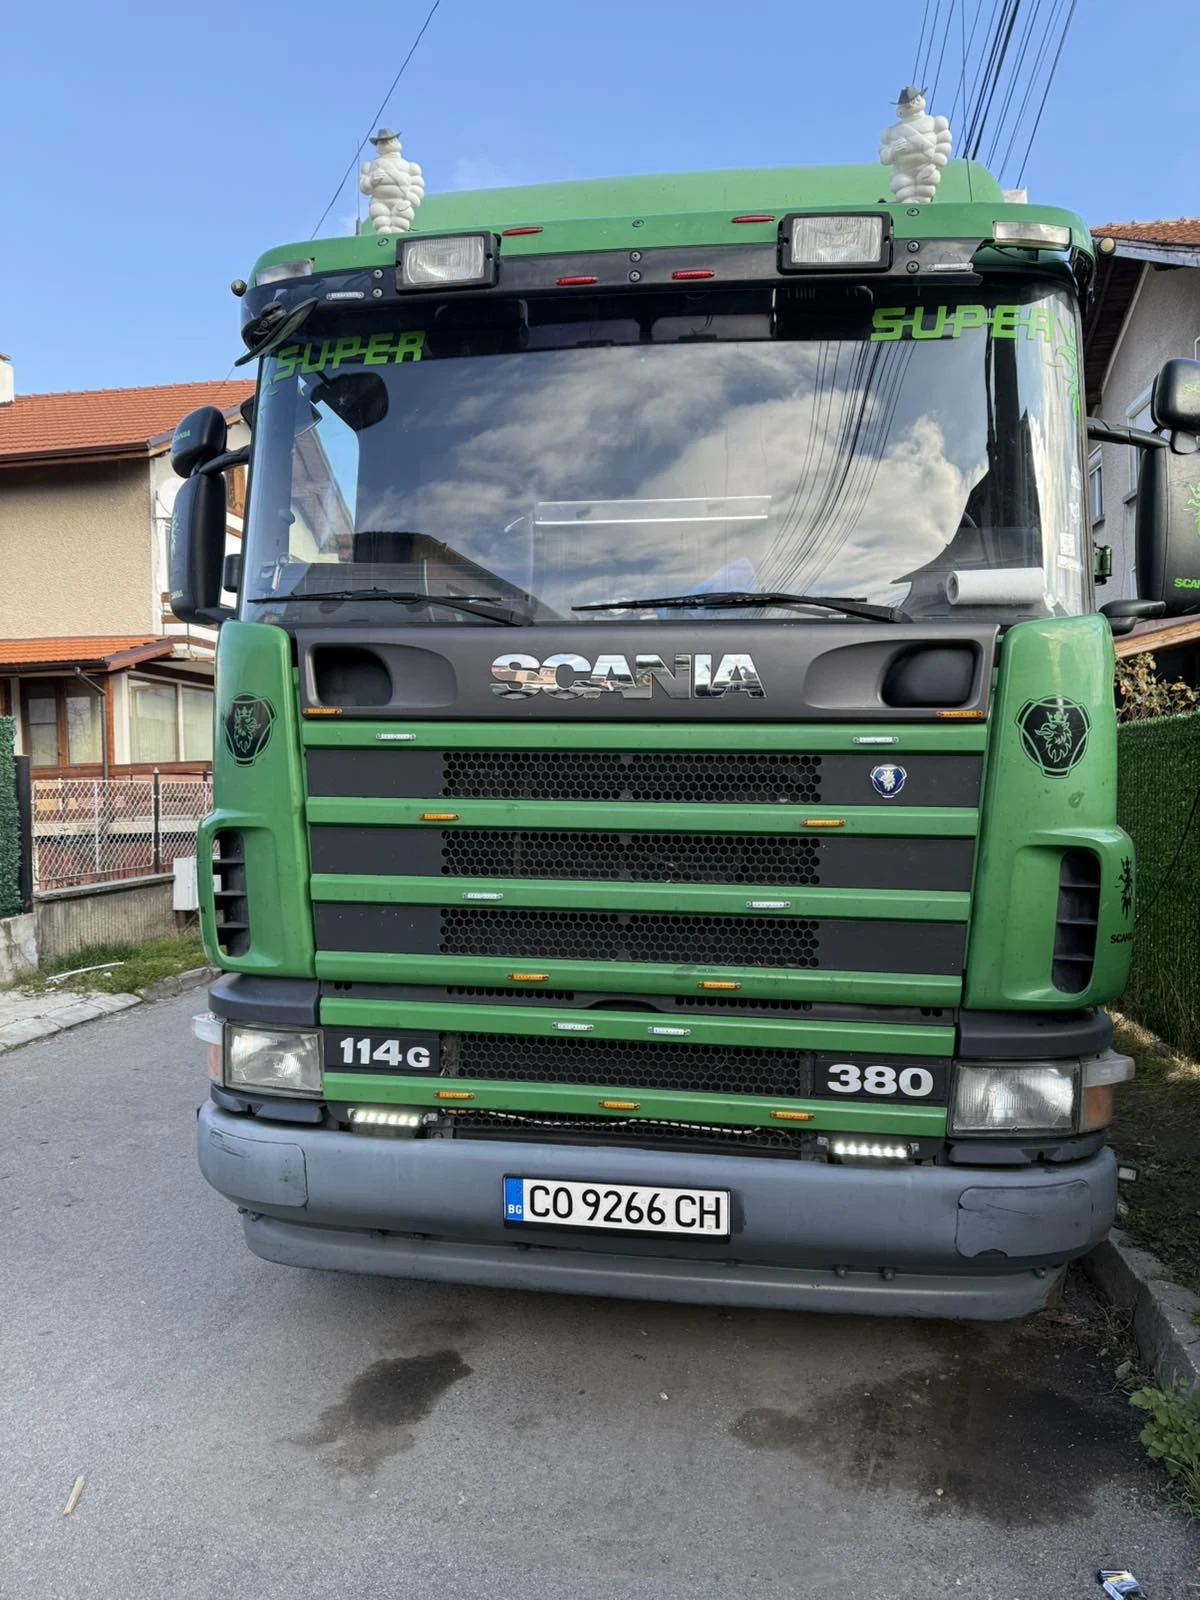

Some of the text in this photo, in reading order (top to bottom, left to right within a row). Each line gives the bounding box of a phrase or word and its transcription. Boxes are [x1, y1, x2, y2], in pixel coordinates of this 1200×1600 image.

[871, 304, 1054, 342] SUPER
[274, 330, 426, 382] SUPER
[490, 653, 768, 700] SCANIA
[827, 1063, 934, 1097] 380
[508, 1204, 523, 1215] BG
[581, 1188, 666, 1225] 9266
[674, 1194, 721, 1230] CH
